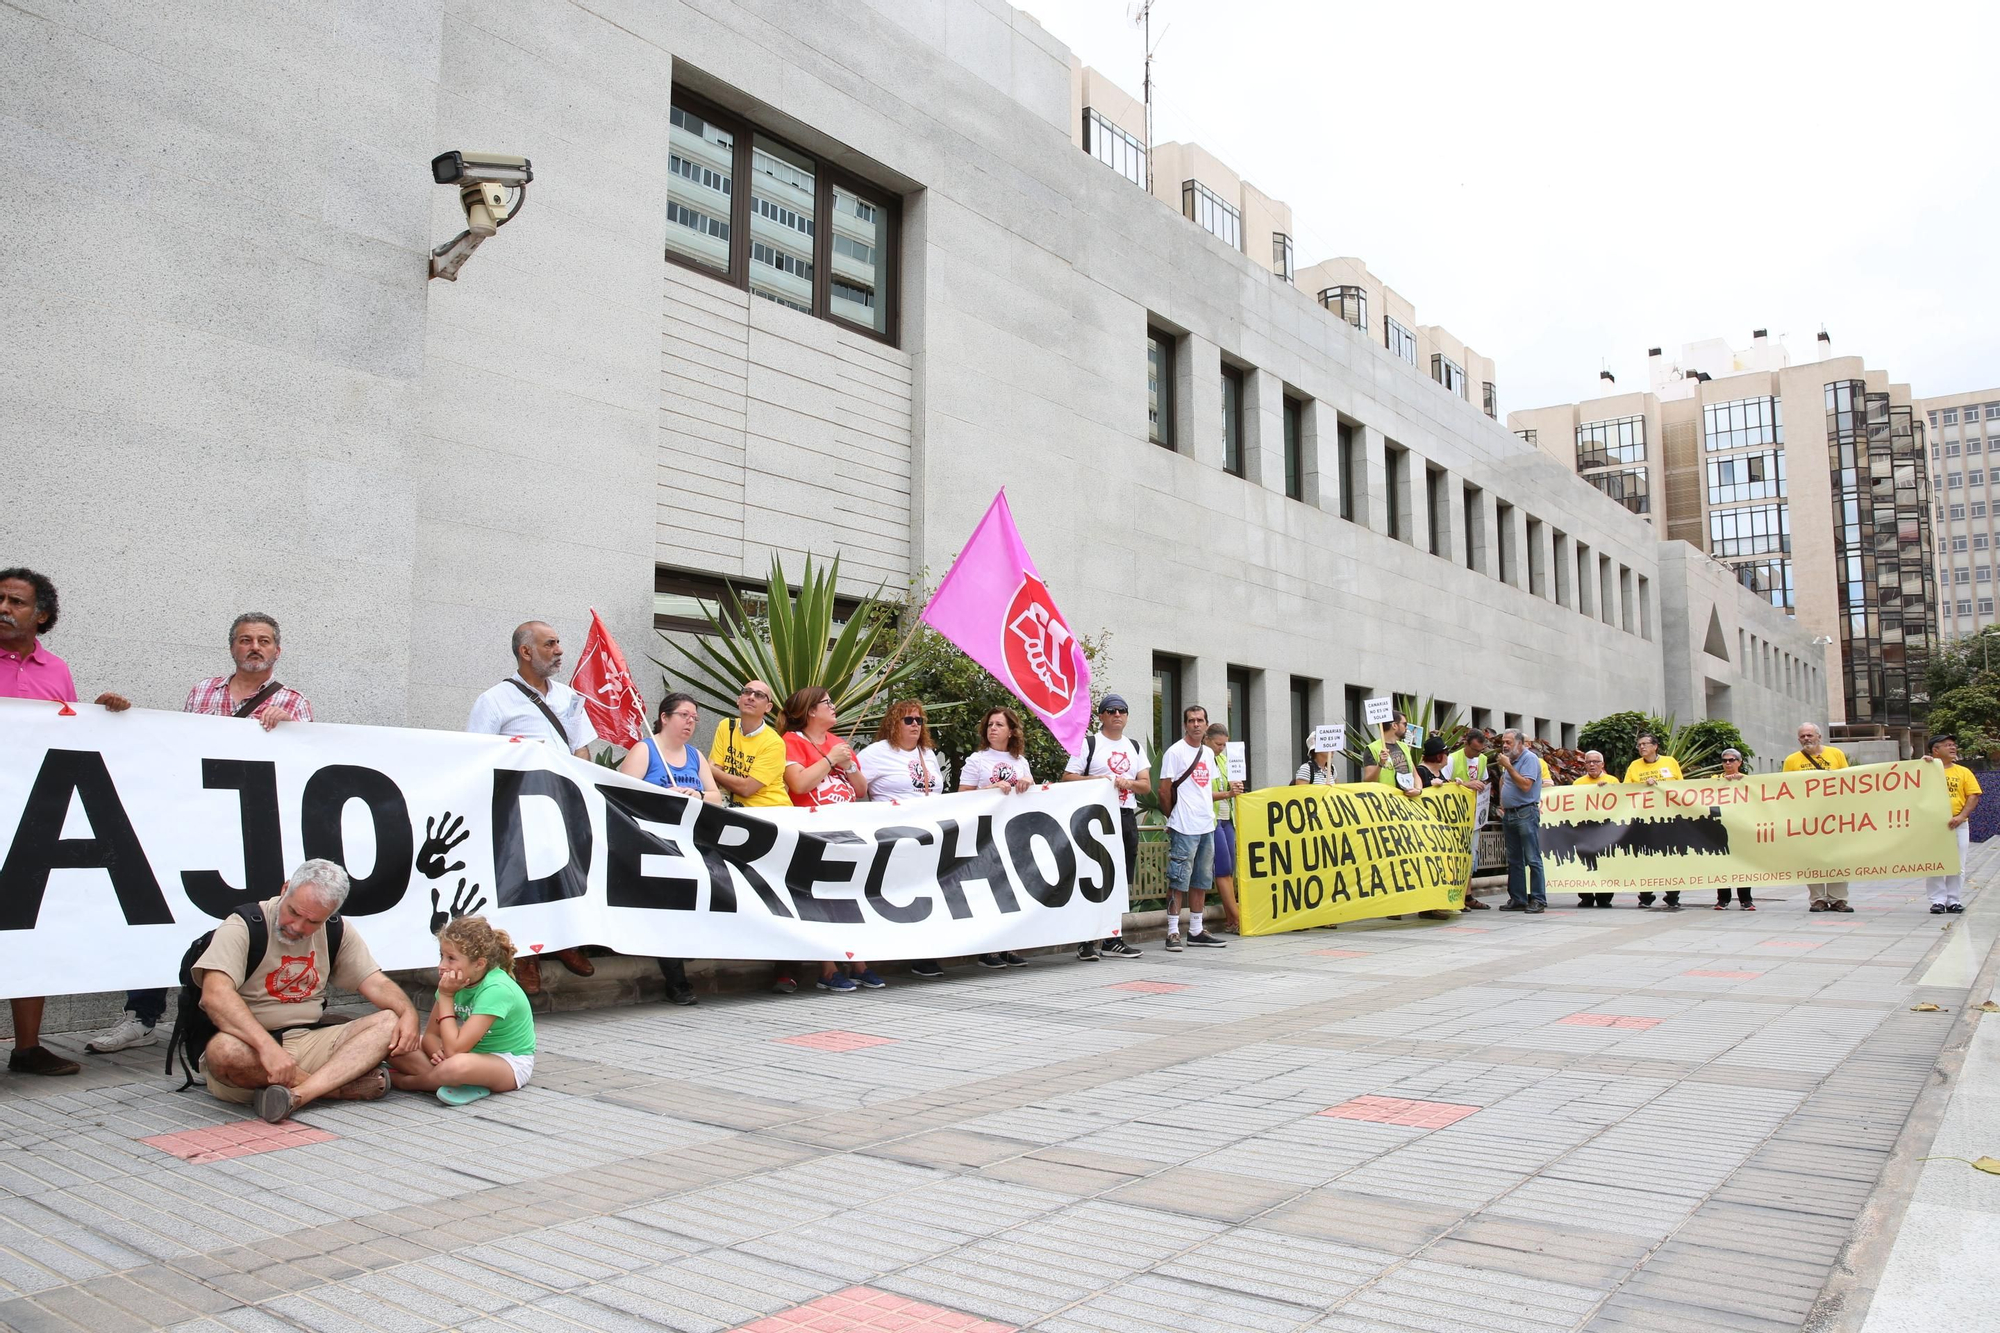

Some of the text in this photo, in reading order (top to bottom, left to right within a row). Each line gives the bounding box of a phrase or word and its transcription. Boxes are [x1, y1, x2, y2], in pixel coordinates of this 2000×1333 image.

[1193, 769, 1209, 777] STOP
[1585, 792, 1618, 812] NO
[1626, 791, 1655, 810] TE
[1665, 784, 1749, 808] ROBEN
[1761, 781, 1795, 802] LA
[1804, 763, 1921, 799] PENSIÓN
[1266, 796, 1324, 838] POR
[1321, 793, 1361, 829] UN
[1786, 812, 1878, 838] LUCHA
[1888, 808, 1910, 829] !!!
[491, 768, 1117, 925] DERECHOS
[1247, 839, 1293, 879] EN
[1300, 831, 1357, 872] UNA
[1356, 823, 1430, 862] TIERRA
[1331, 870, 1351, 903] A
[1354, 864, 1388, 898] LA
[1389, 856, 1425, 893] LEY
[1600, 879, 1621, 888] POR
[1623, 878, 1637, 887] LA
[1640, 877, 1686, 887] DEFENSA
[1689, 876, 1704, 885] DE
[1707, 875, 1728, 884] LAS
[1731, 871, 1792, 883] PENSIONES
[1796, 867, 1851, 880] PÚBLICAS
[1855, 866, 1888, 876] GRAN
[1891, 862, 1945, 874] CANARIA
